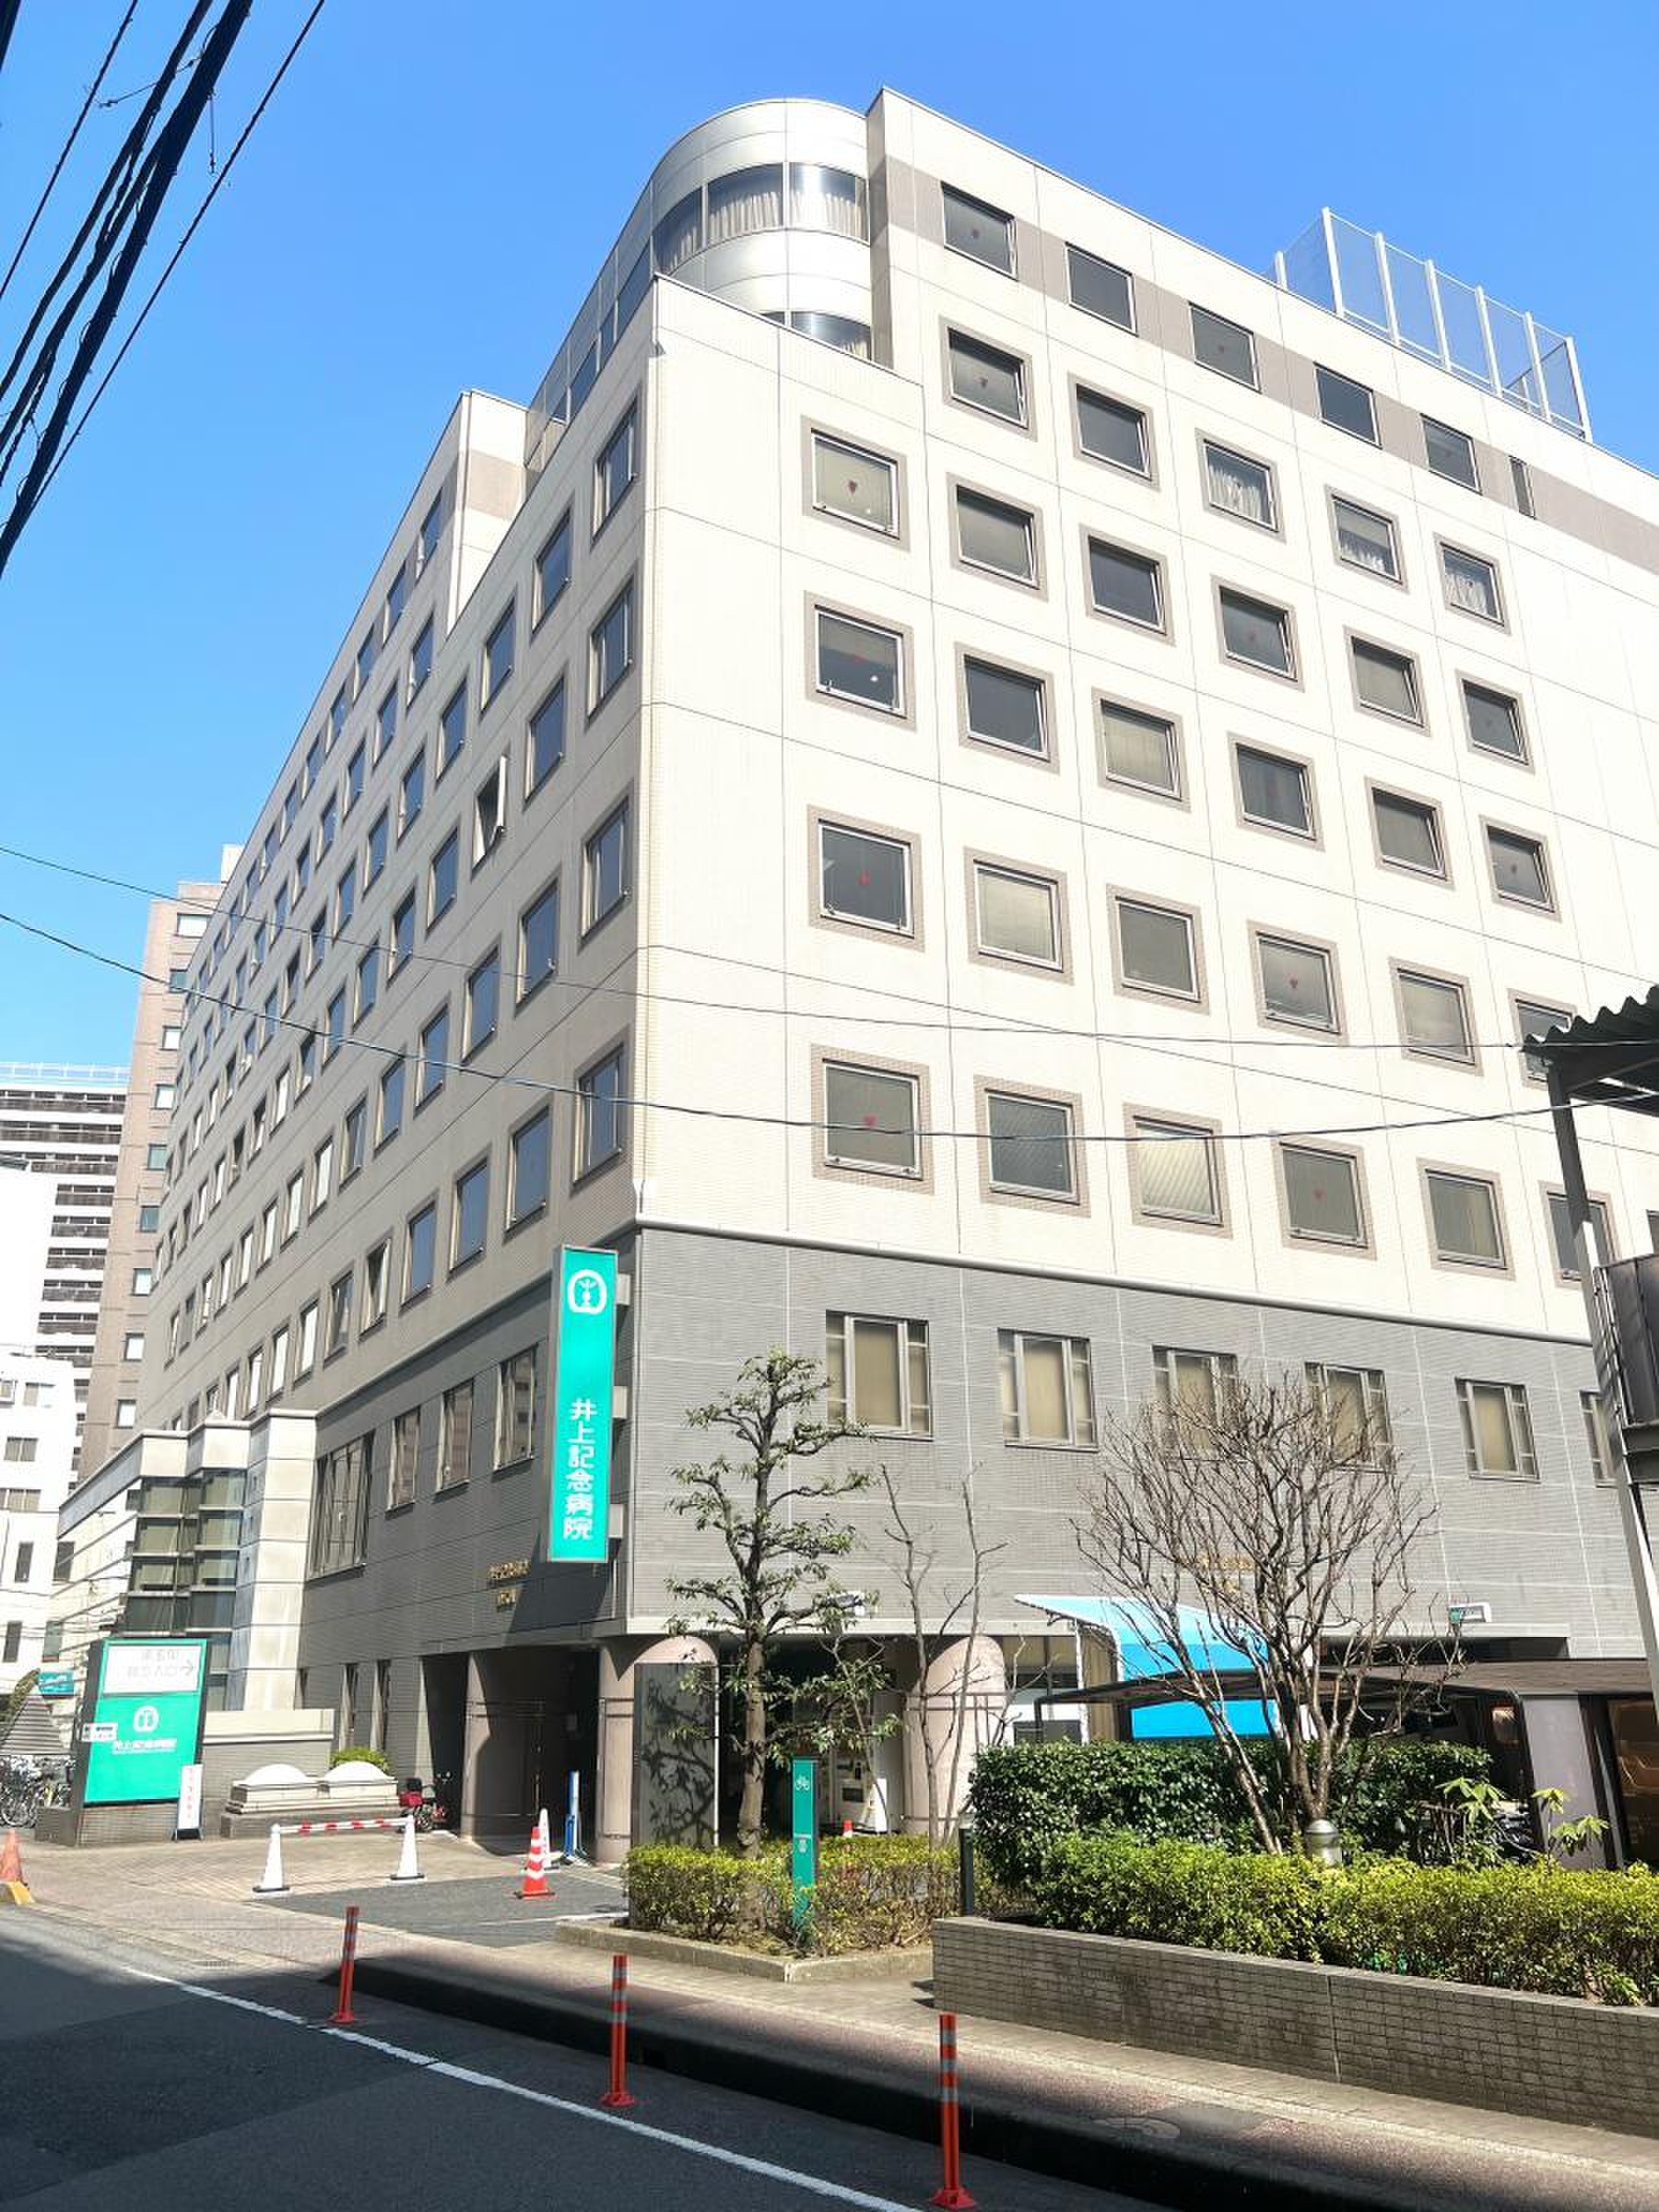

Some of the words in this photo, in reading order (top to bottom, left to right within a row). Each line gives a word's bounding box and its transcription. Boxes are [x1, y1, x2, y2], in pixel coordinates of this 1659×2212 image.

[562, 1397, 598, 1540] 井上記念病院
